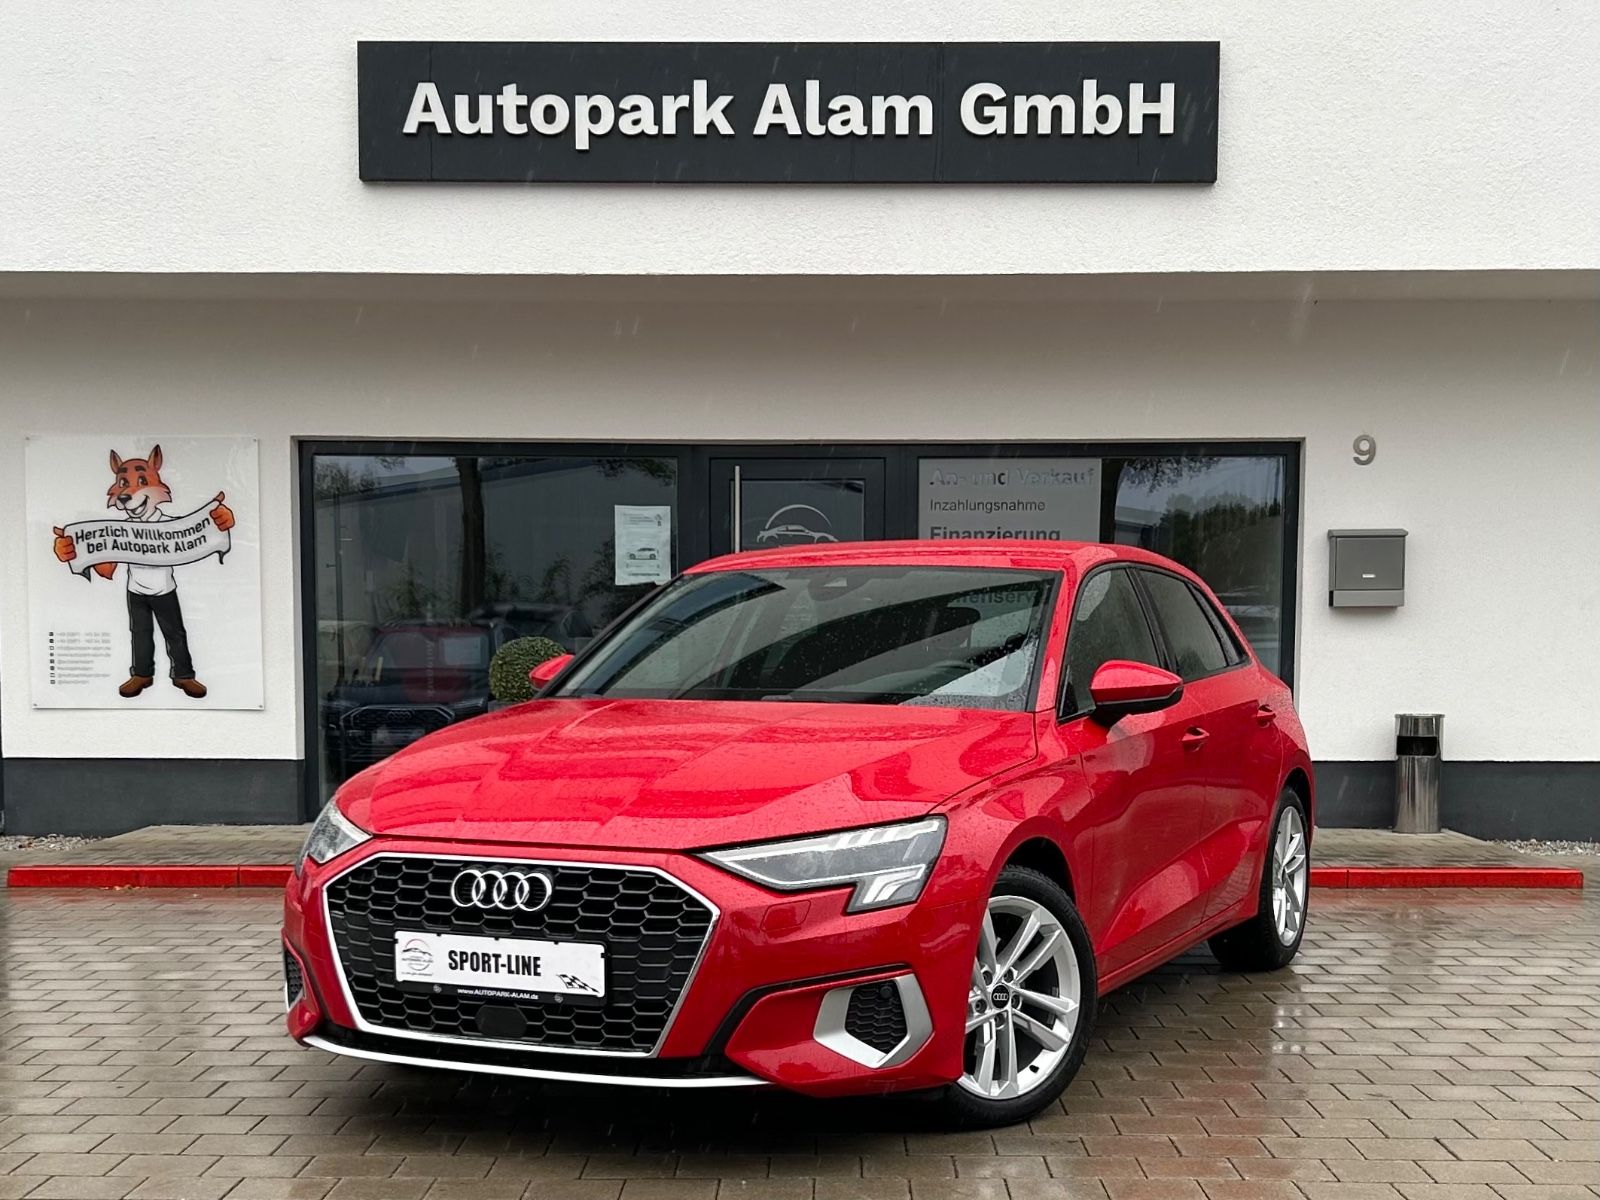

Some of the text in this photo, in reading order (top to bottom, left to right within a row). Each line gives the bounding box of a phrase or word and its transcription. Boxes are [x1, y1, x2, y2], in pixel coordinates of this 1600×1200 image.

[402, 79, 1176, 151] Autopark Alam GmbH
[1352, 434, 1377, 466] 9
[929, 467, 1095, 486] An- und Verkauf
[930, 499, 1046, 513] Inzahlungsnahme
[75, 517, 211, 544] Herzlich Willkommen
[87, 534, 207, 555] bei Autopark Alam
[448, 949, 542, 977] SPORT-LINE
